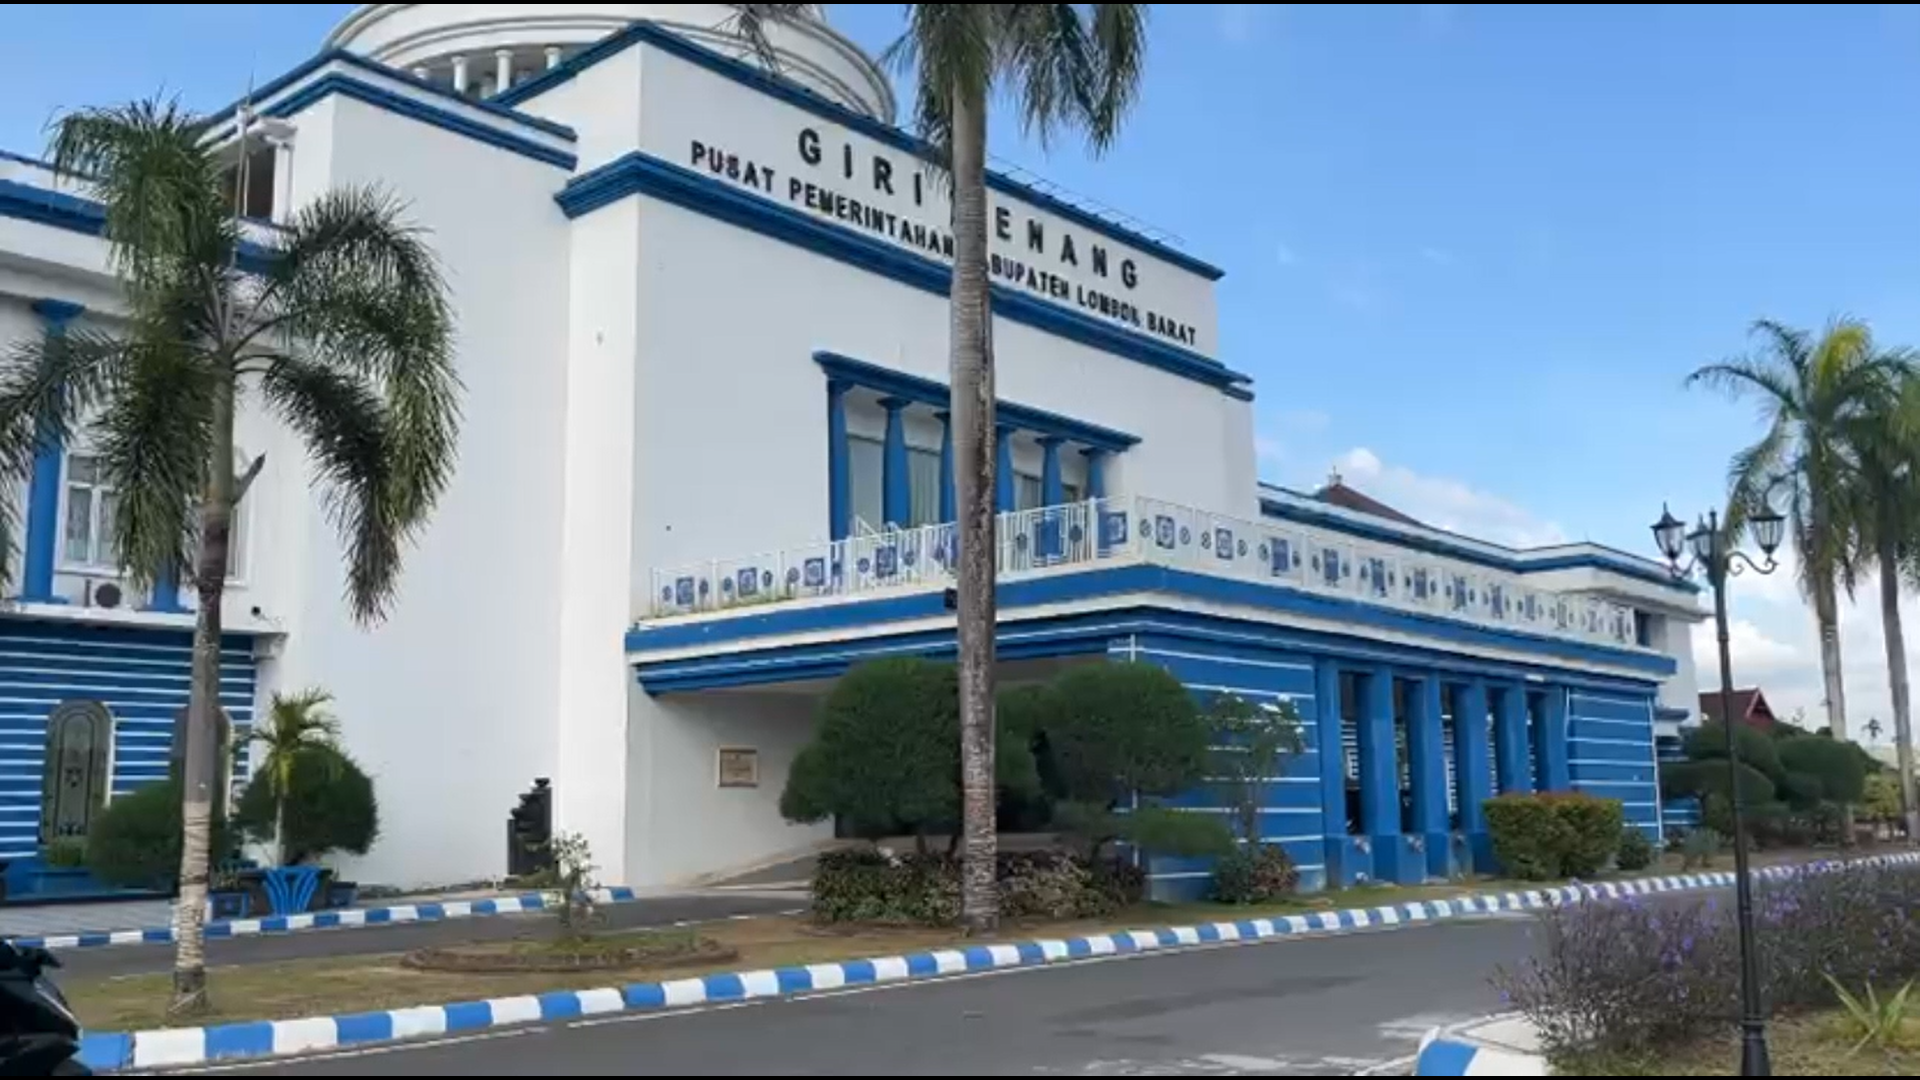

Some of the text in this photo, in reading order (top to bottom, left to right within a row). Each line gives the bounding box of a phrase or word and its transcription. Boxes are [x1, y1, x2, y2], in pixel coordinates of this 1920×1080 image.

[691, 141, 775, 192] PUSAT
[789, 177, 954, 258] PEMERINTAHAN
[990, 253, 1070, 299] BUPATEN
[1147, 311, 1196, 346] BARAT
[798, 128, 1138, 290] GIRI ENANG
